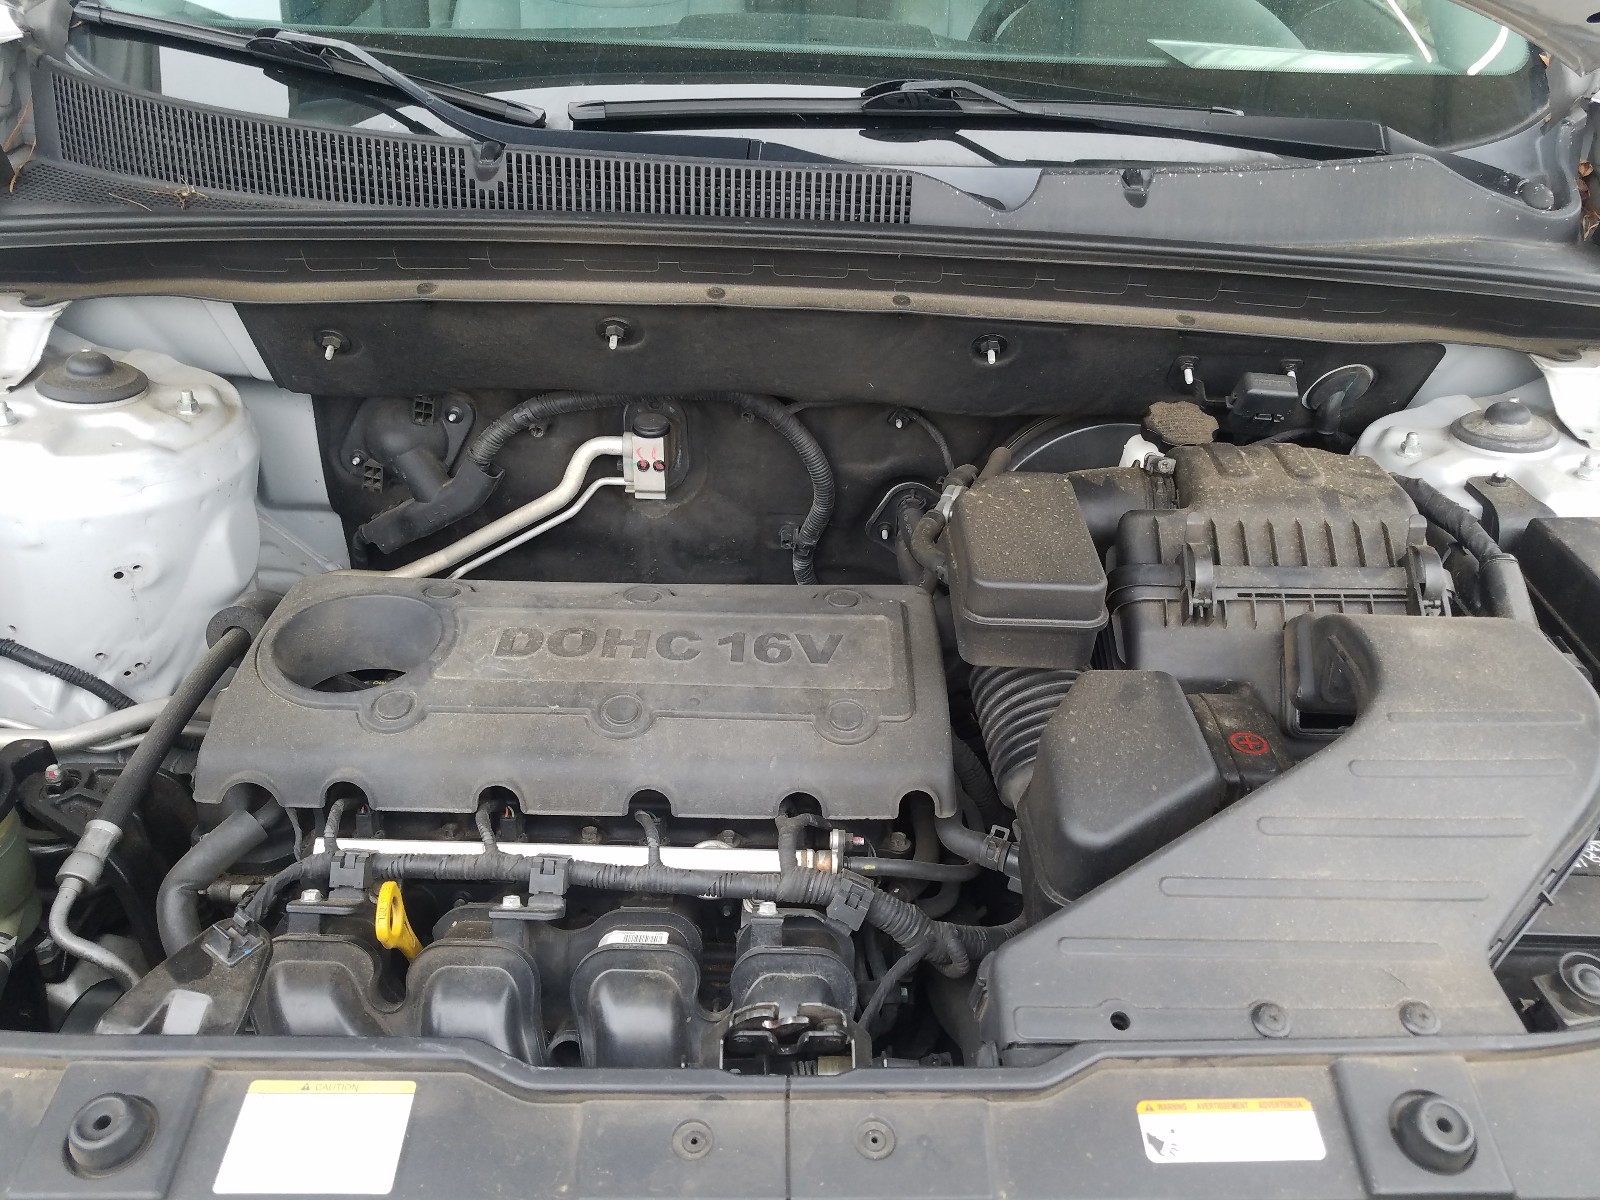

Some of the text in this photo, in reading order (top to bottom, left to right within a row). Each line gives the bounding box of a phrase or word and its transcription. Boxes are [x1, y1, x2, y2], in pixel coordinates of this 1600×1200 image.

[495, 627, 844, 665] DOHC 16V
[315, 1083, 359, 1092] CAUTION
[1156, 1102, 1188, 1111] WARNING
